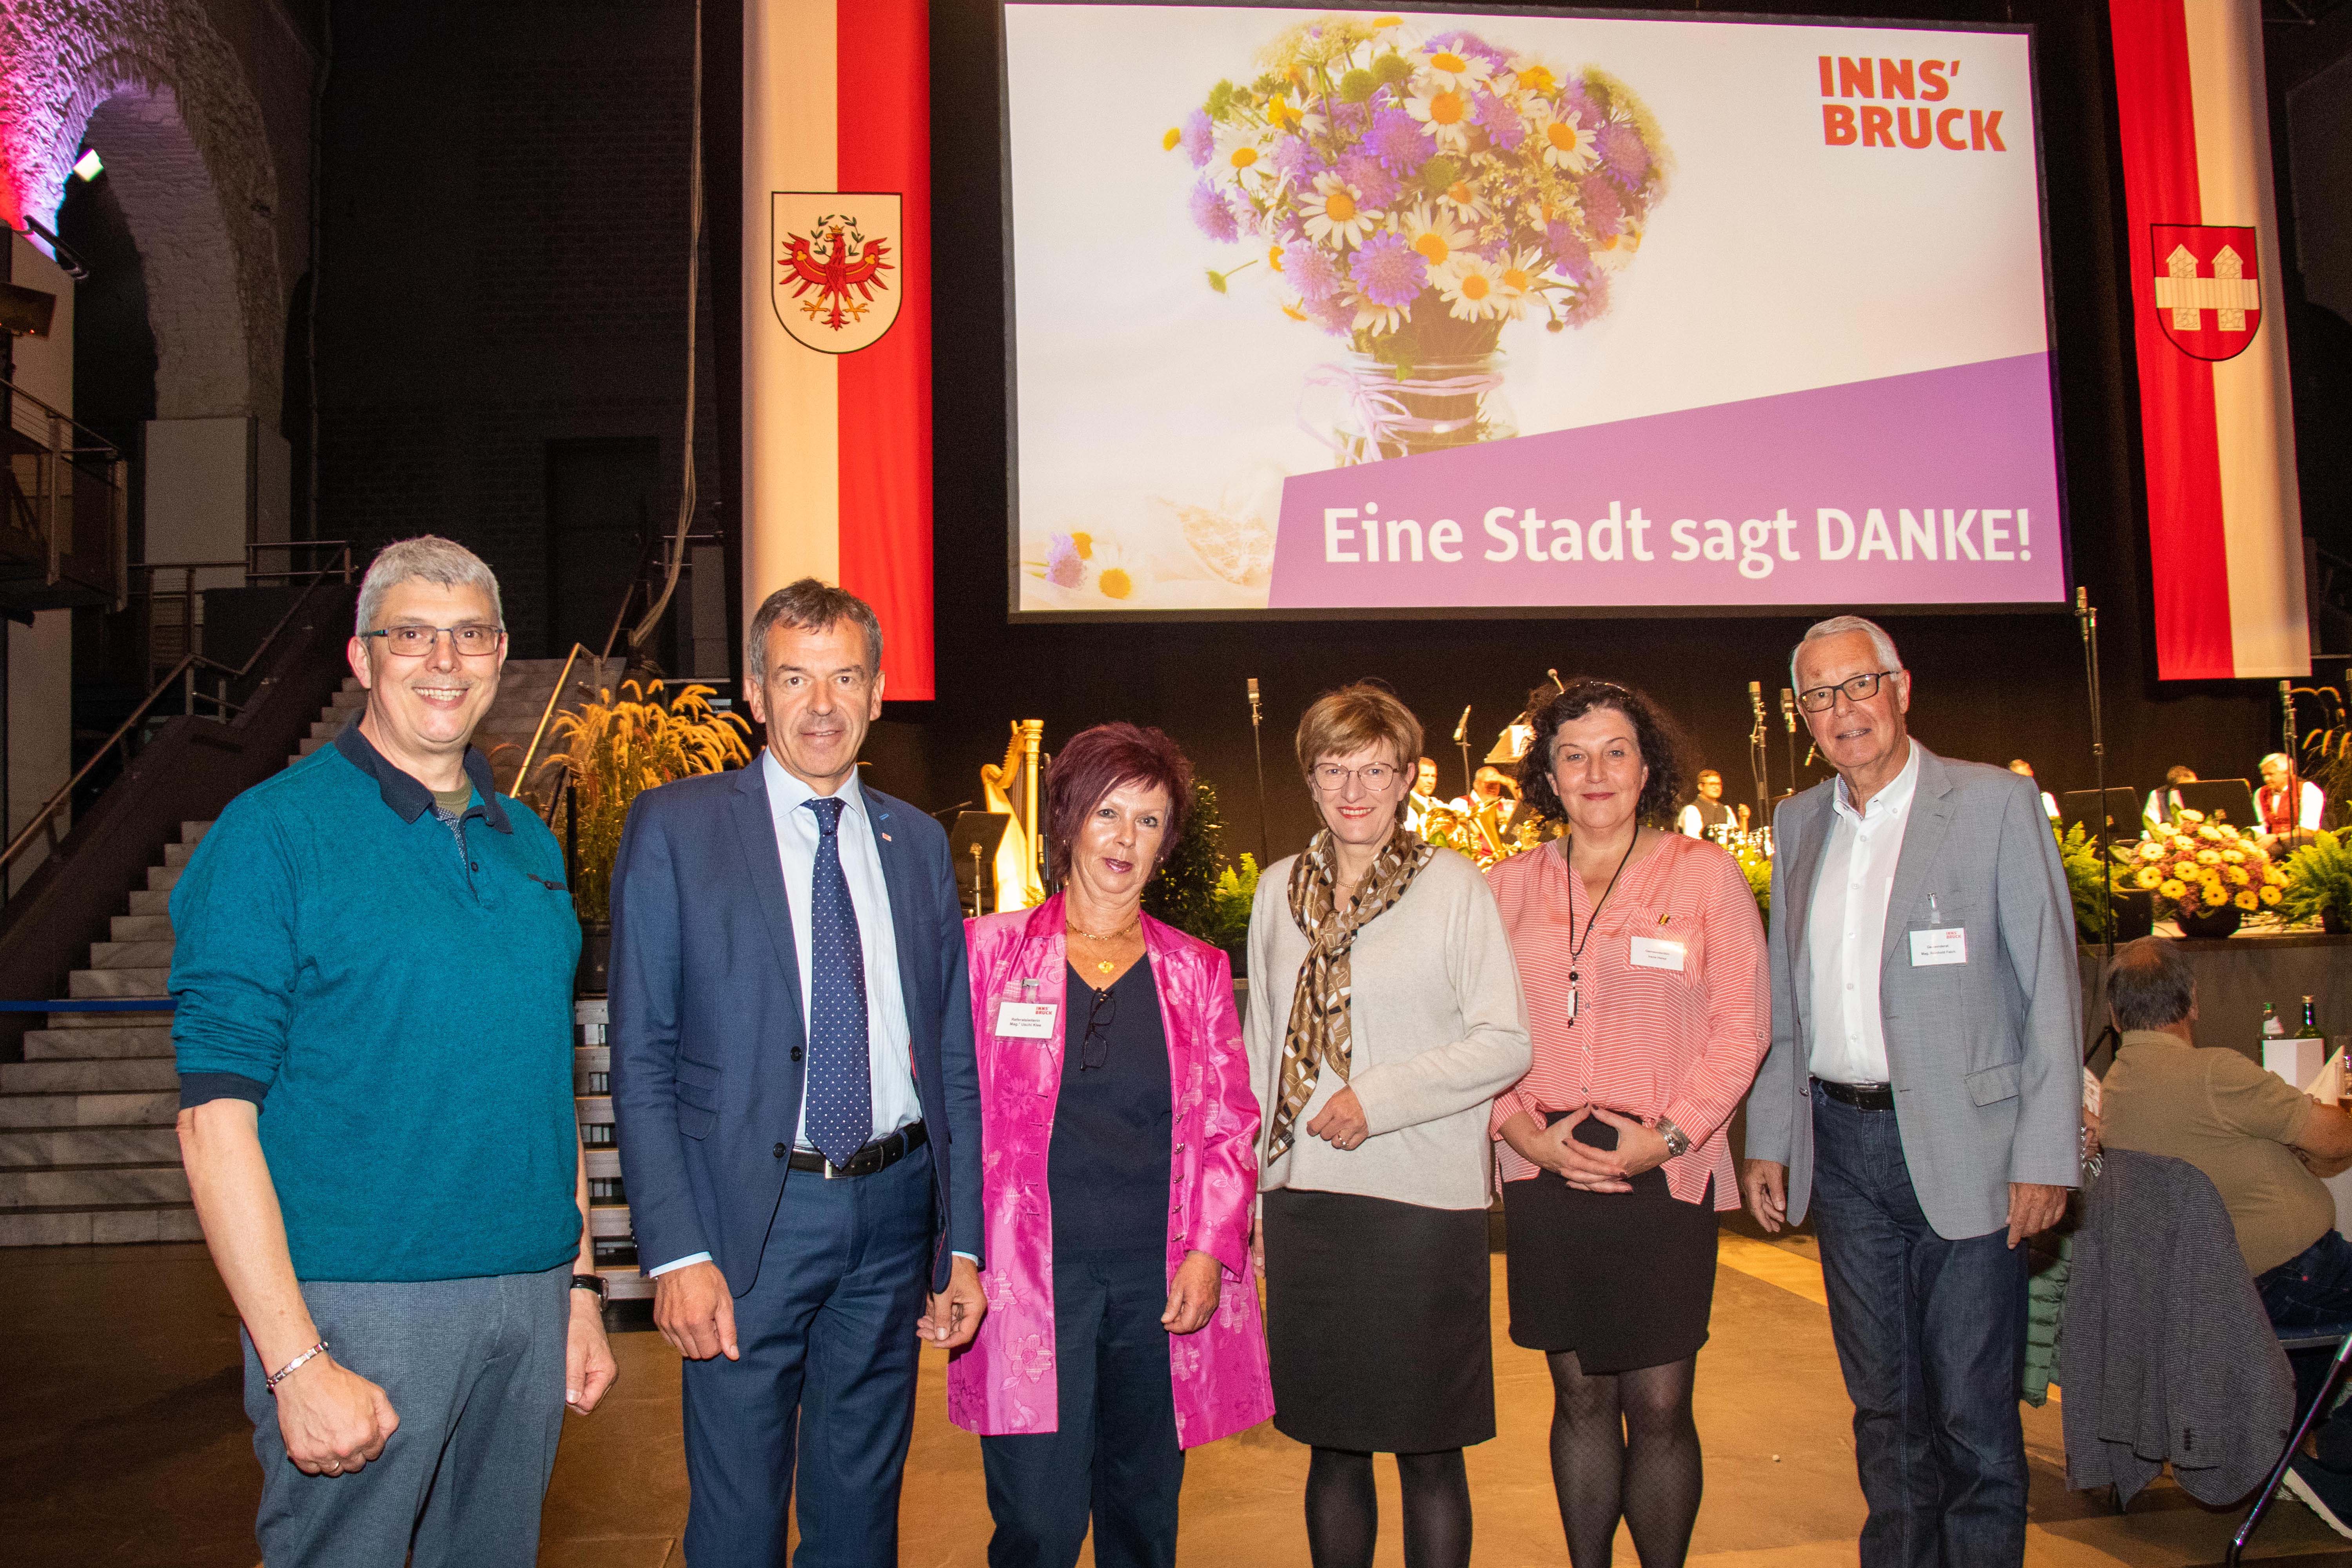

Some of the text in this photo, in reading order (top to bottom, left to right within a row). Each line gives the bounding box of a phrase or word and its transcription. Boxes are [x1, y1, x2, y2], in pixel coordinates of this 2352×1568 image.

[1818, 56, 1960, 102] INNS'
[1822, 104, 2007, 152] BRUCK
[1324, 501, 2031, 579] Eine Stadt sagt DANKE!
